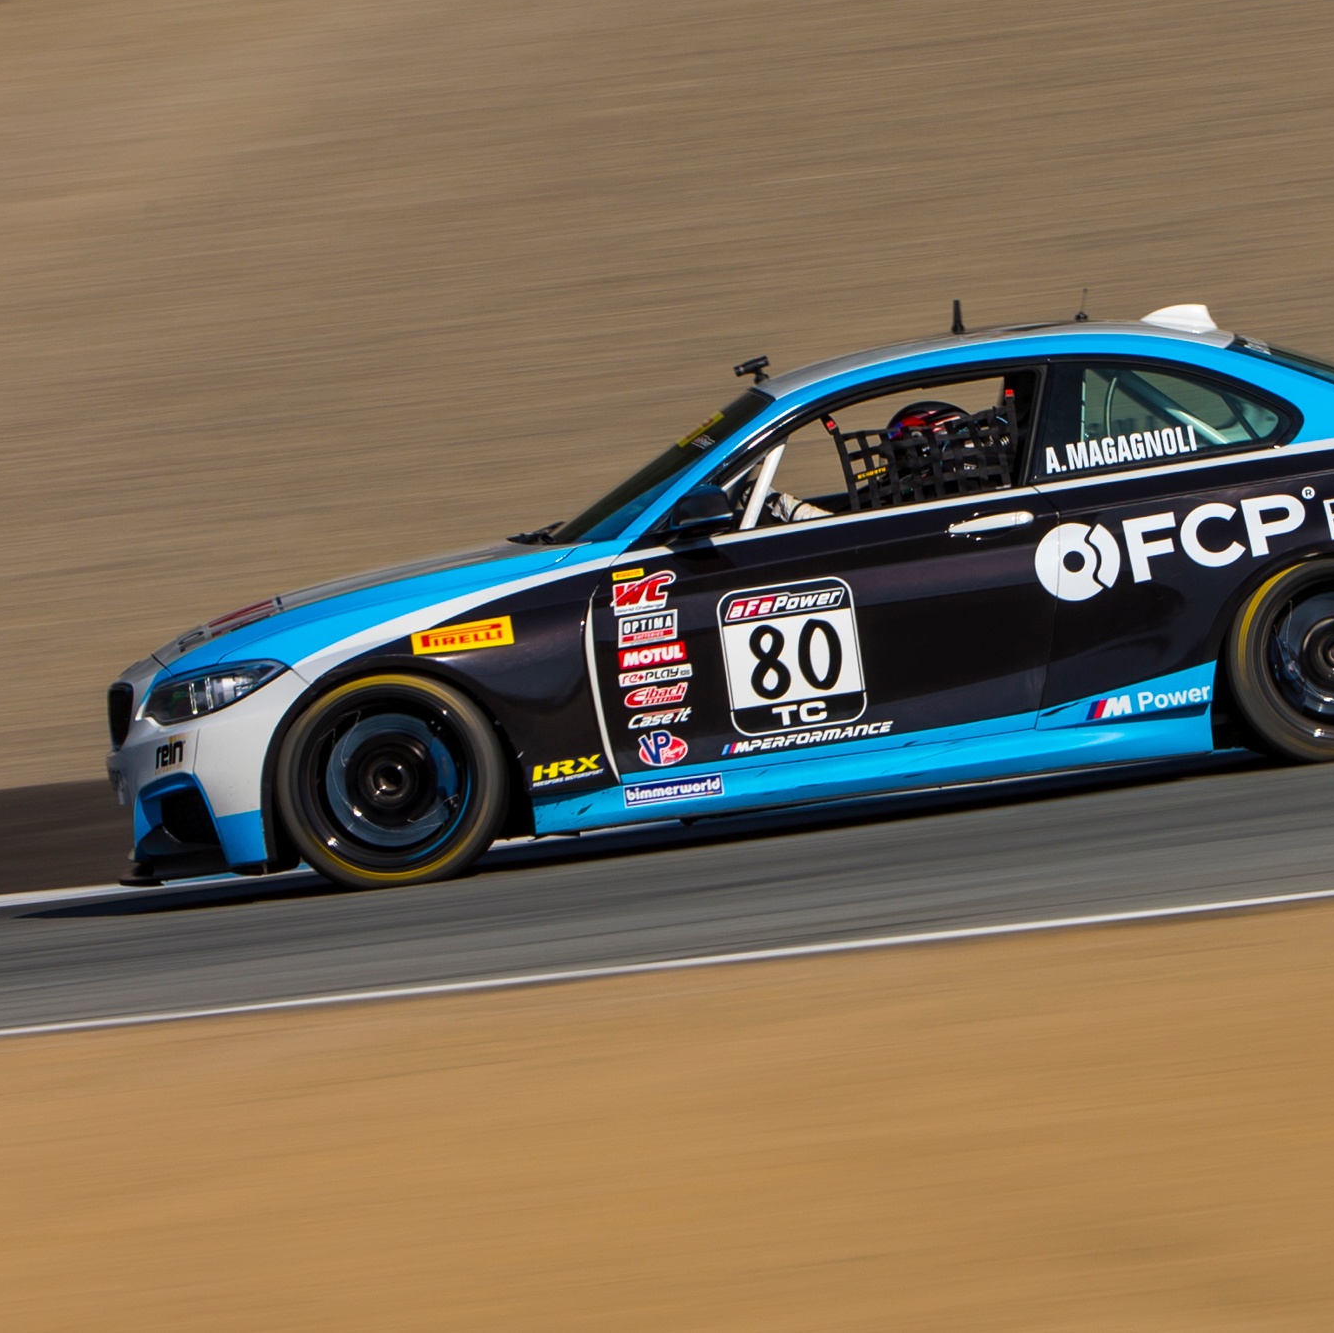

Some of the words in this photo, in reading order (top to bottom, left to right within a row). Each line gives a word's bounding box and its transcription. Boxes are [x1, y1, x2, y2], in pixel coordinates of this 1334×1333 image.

[1122, 494, 1306, 583] FCP
[614, 576, 672, 608] WC
[421, 623, 503, 648] PIRELLI
[623, 615, 673, 635] OPTIMA
[623, 645, 684, 667] MOTUL
[749, 618, 842, 700] 80
[626, 683, 686, 707] Eibach
[1101, 695, 1133, 719] M
[1137, 685, 1211, 712] Power
[628, 712, 674, 729] Case
[772, 701, 828, 726] TC
[156, 739, 185, 770] rein
[639, 730, 672, 766] VP
[532, 753, 601, 781] HRX
[627, 777, 721, 801] bimmerworld
